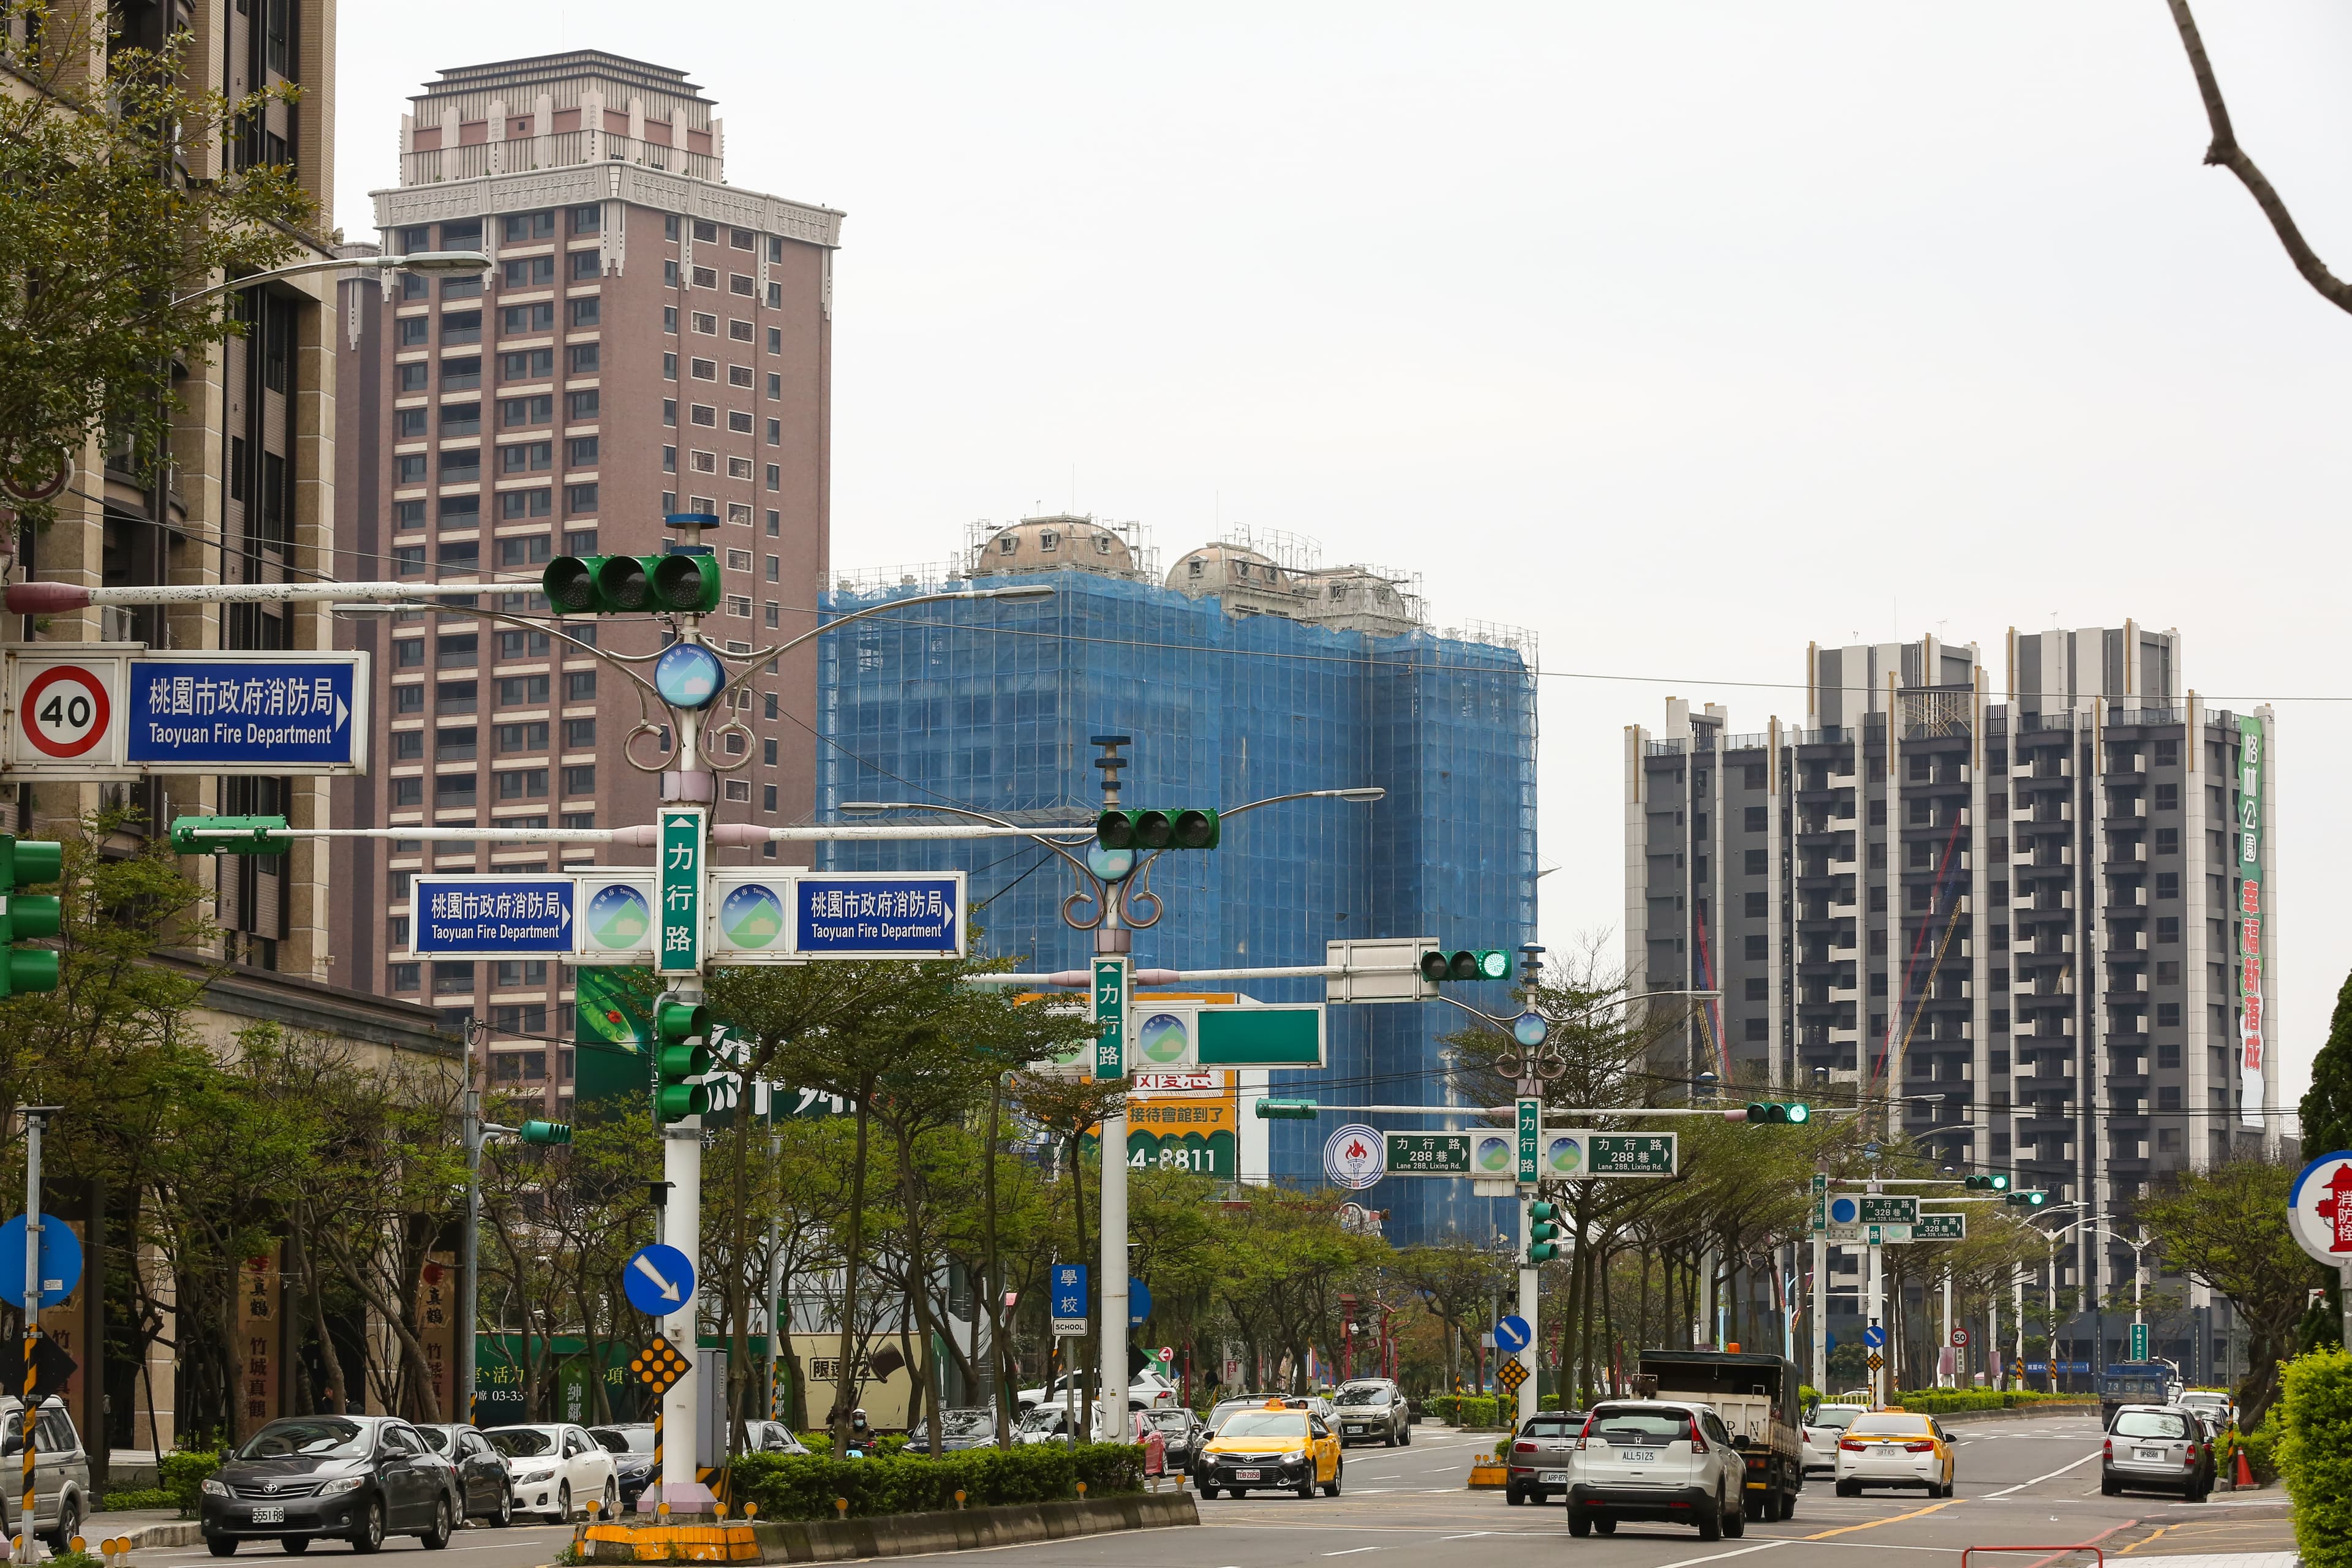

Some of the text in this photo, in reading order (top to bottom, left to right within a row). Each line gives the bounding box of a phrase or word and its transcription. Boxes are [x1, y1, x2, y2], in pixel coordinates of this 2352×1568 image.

[149, 677, 333, 715] 桃園市政府消防局
[40, 696, 90, 728] 40
[149, 723, 331, 748] Taoyuan Fire Department
[431, 892, 560, 919] 桃園市政府消防局
[666, 843, 693, 951] 力行路
[811, 891, 942, 918] 桃園市政府消防局
[2242, 733, 2261, 1071] 格林公園 幸福新落成
[431, 924, 559, 942] Taoyuan Fire Department
[812, 923, 941, 941] Taoyuan Fire Department
[1099, 984, 1119, 1065] 力行路
[1130, 1107, 1224, 1123] 接待會館到了
[1397, 1138, 1460, 1150] 力行路
[1520, 1117, 1535, 1172] 力行路
[1599, 1139, 1662, 1150] 力行路
[2337, 1191, 2352, 1242] 消防栓
[1870, 1231, 1879, 1239] 路
[1061, 1270, 1077, 1313] 學校
[1623, 1452, 1654, 1461] ALL-5123
